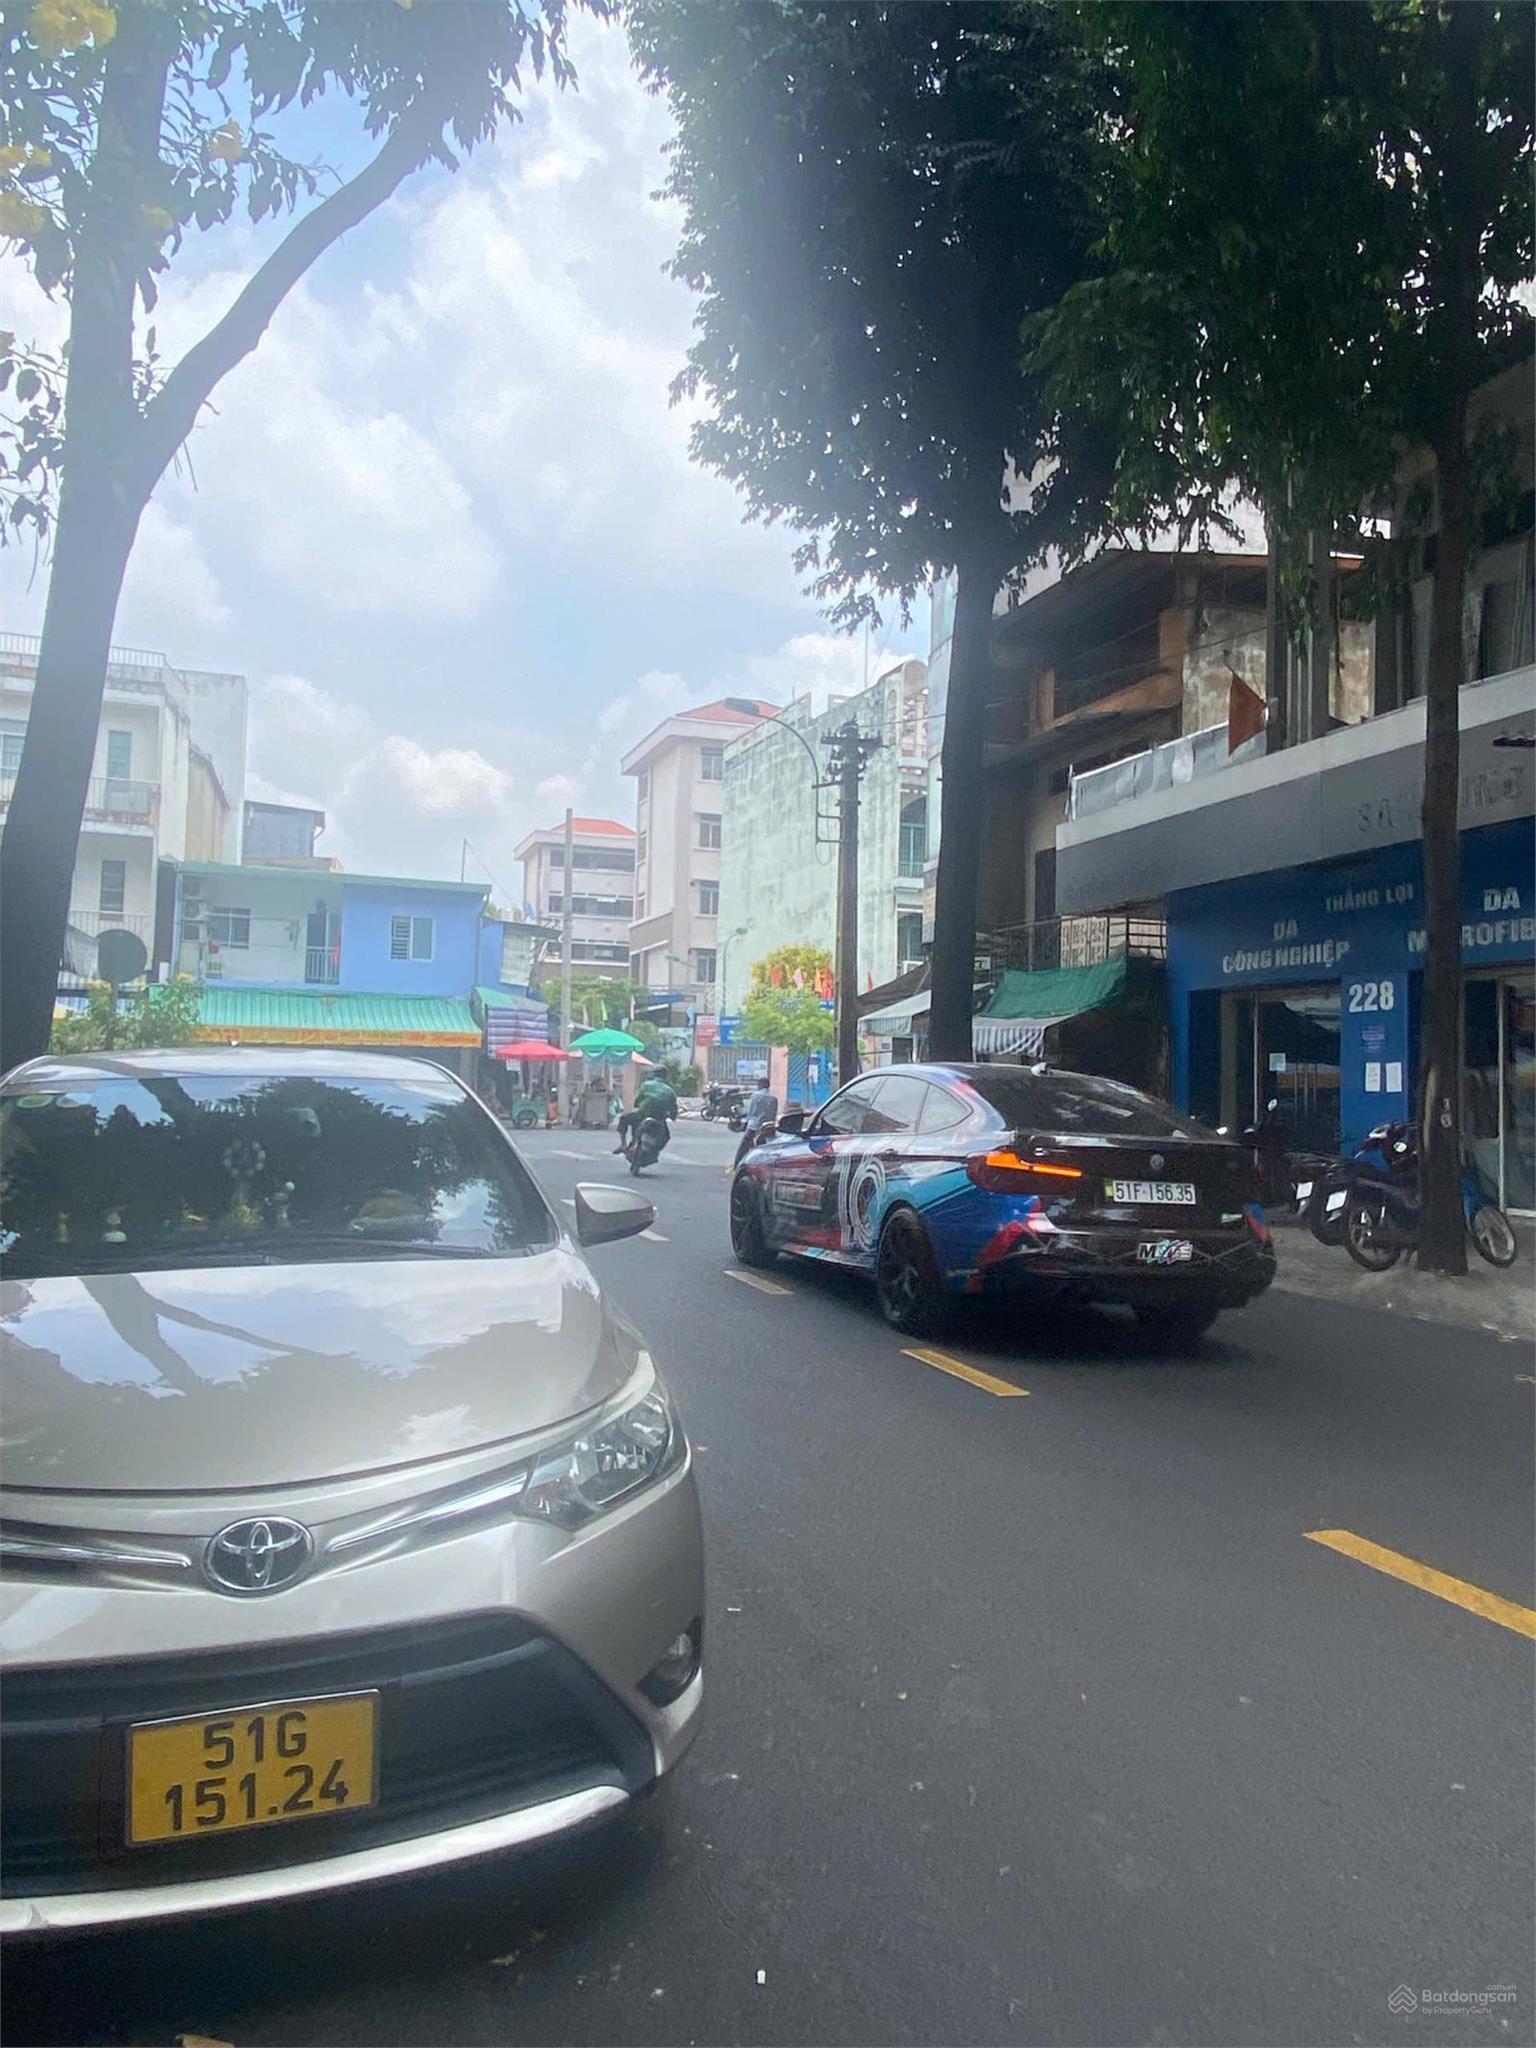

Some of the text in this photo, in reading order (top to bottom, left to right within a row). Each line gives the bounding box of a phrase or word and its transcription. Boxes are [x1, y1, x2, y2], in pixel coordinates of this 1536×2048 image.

[1483, 887, 1520, 912] DA
[1222, 939, 1350, 974] CÔNG NGHIỆP
[1348, 981, 1395, 1013] 228
[203, 1711, 307, 1770] 51G
[165, 1758, 349, 1831] 151.24
